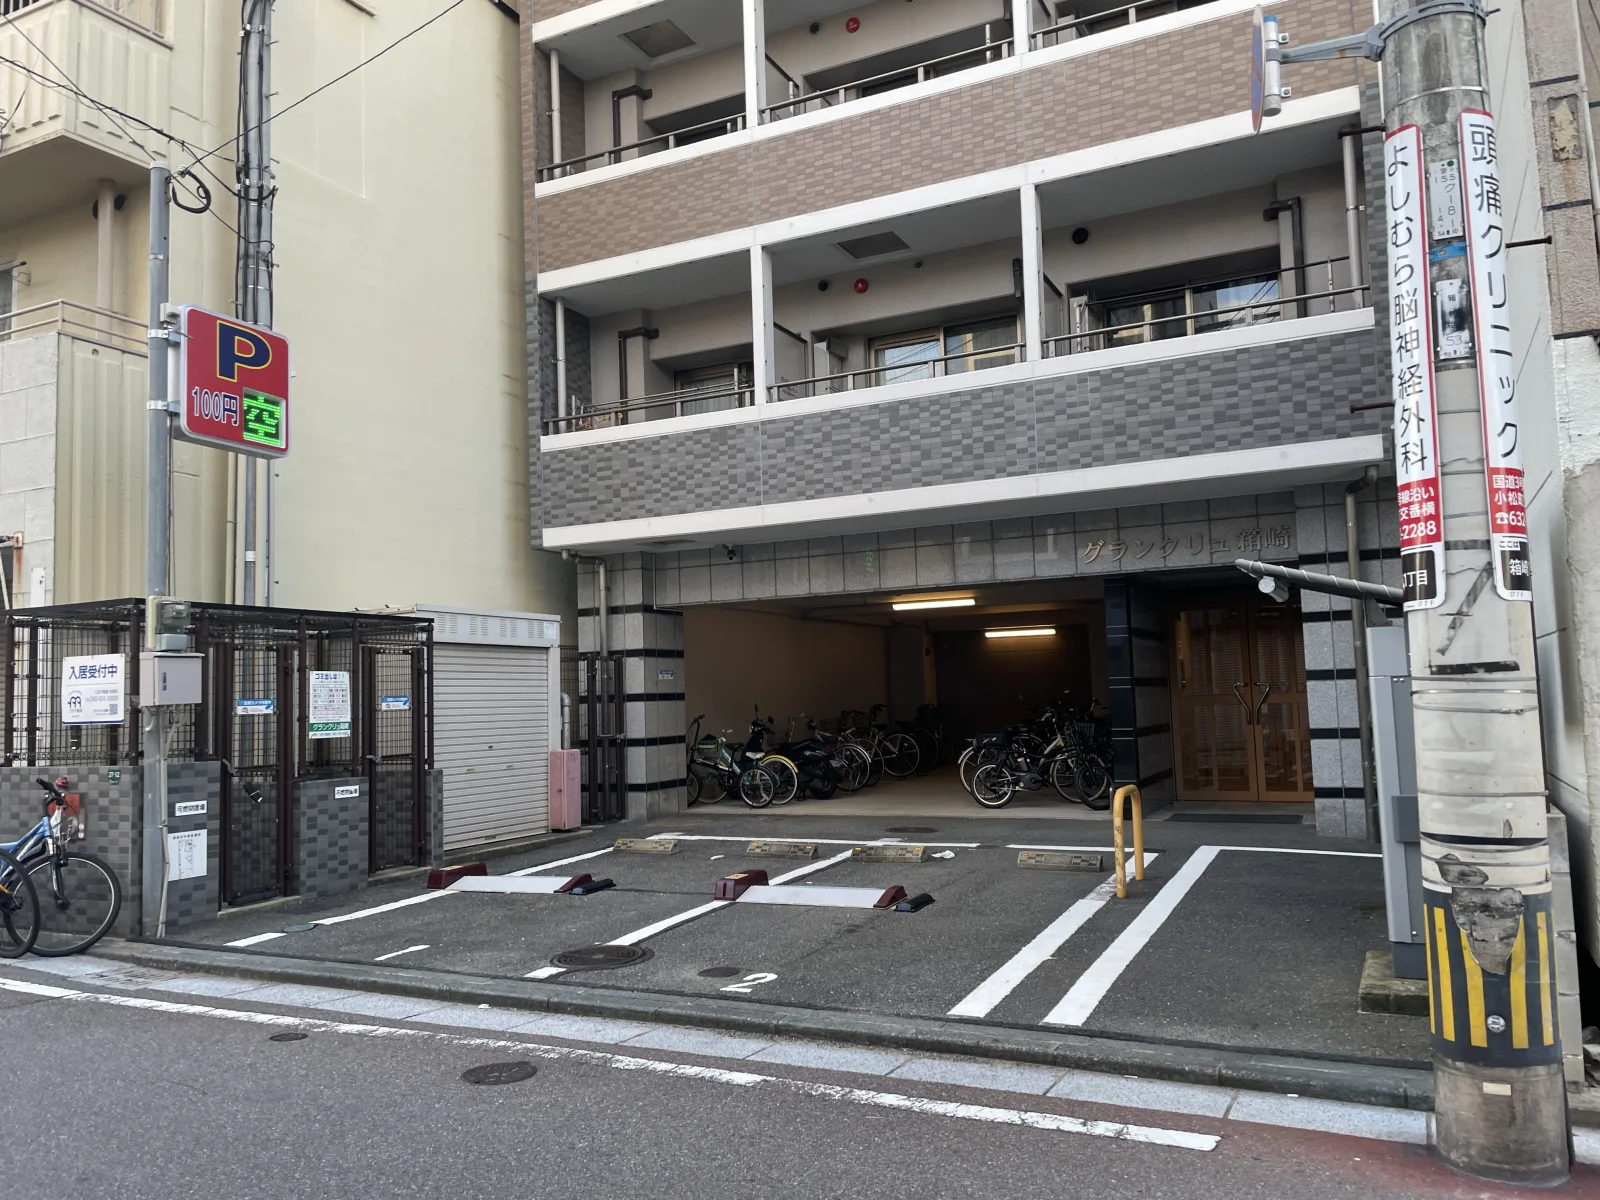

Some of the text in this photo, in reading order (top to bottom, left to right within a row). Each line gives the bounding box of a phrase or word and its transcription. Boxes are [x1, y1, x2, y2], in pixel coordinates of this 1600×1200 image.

[1387, 145, 1428, 475] よしむら脳神経外科
[1469, 124, 1518, 459] 頭痛クリニック
[216, 320, 272, 382] P
[192, 386, 239, 427] 100円
[243, 396, 281, 447] 空
[1083, 524, 1291, 565] グランクリュ箱崎
[68, 664, 118, 680] 入居受付中
[719, 973, 778, 992] 2
